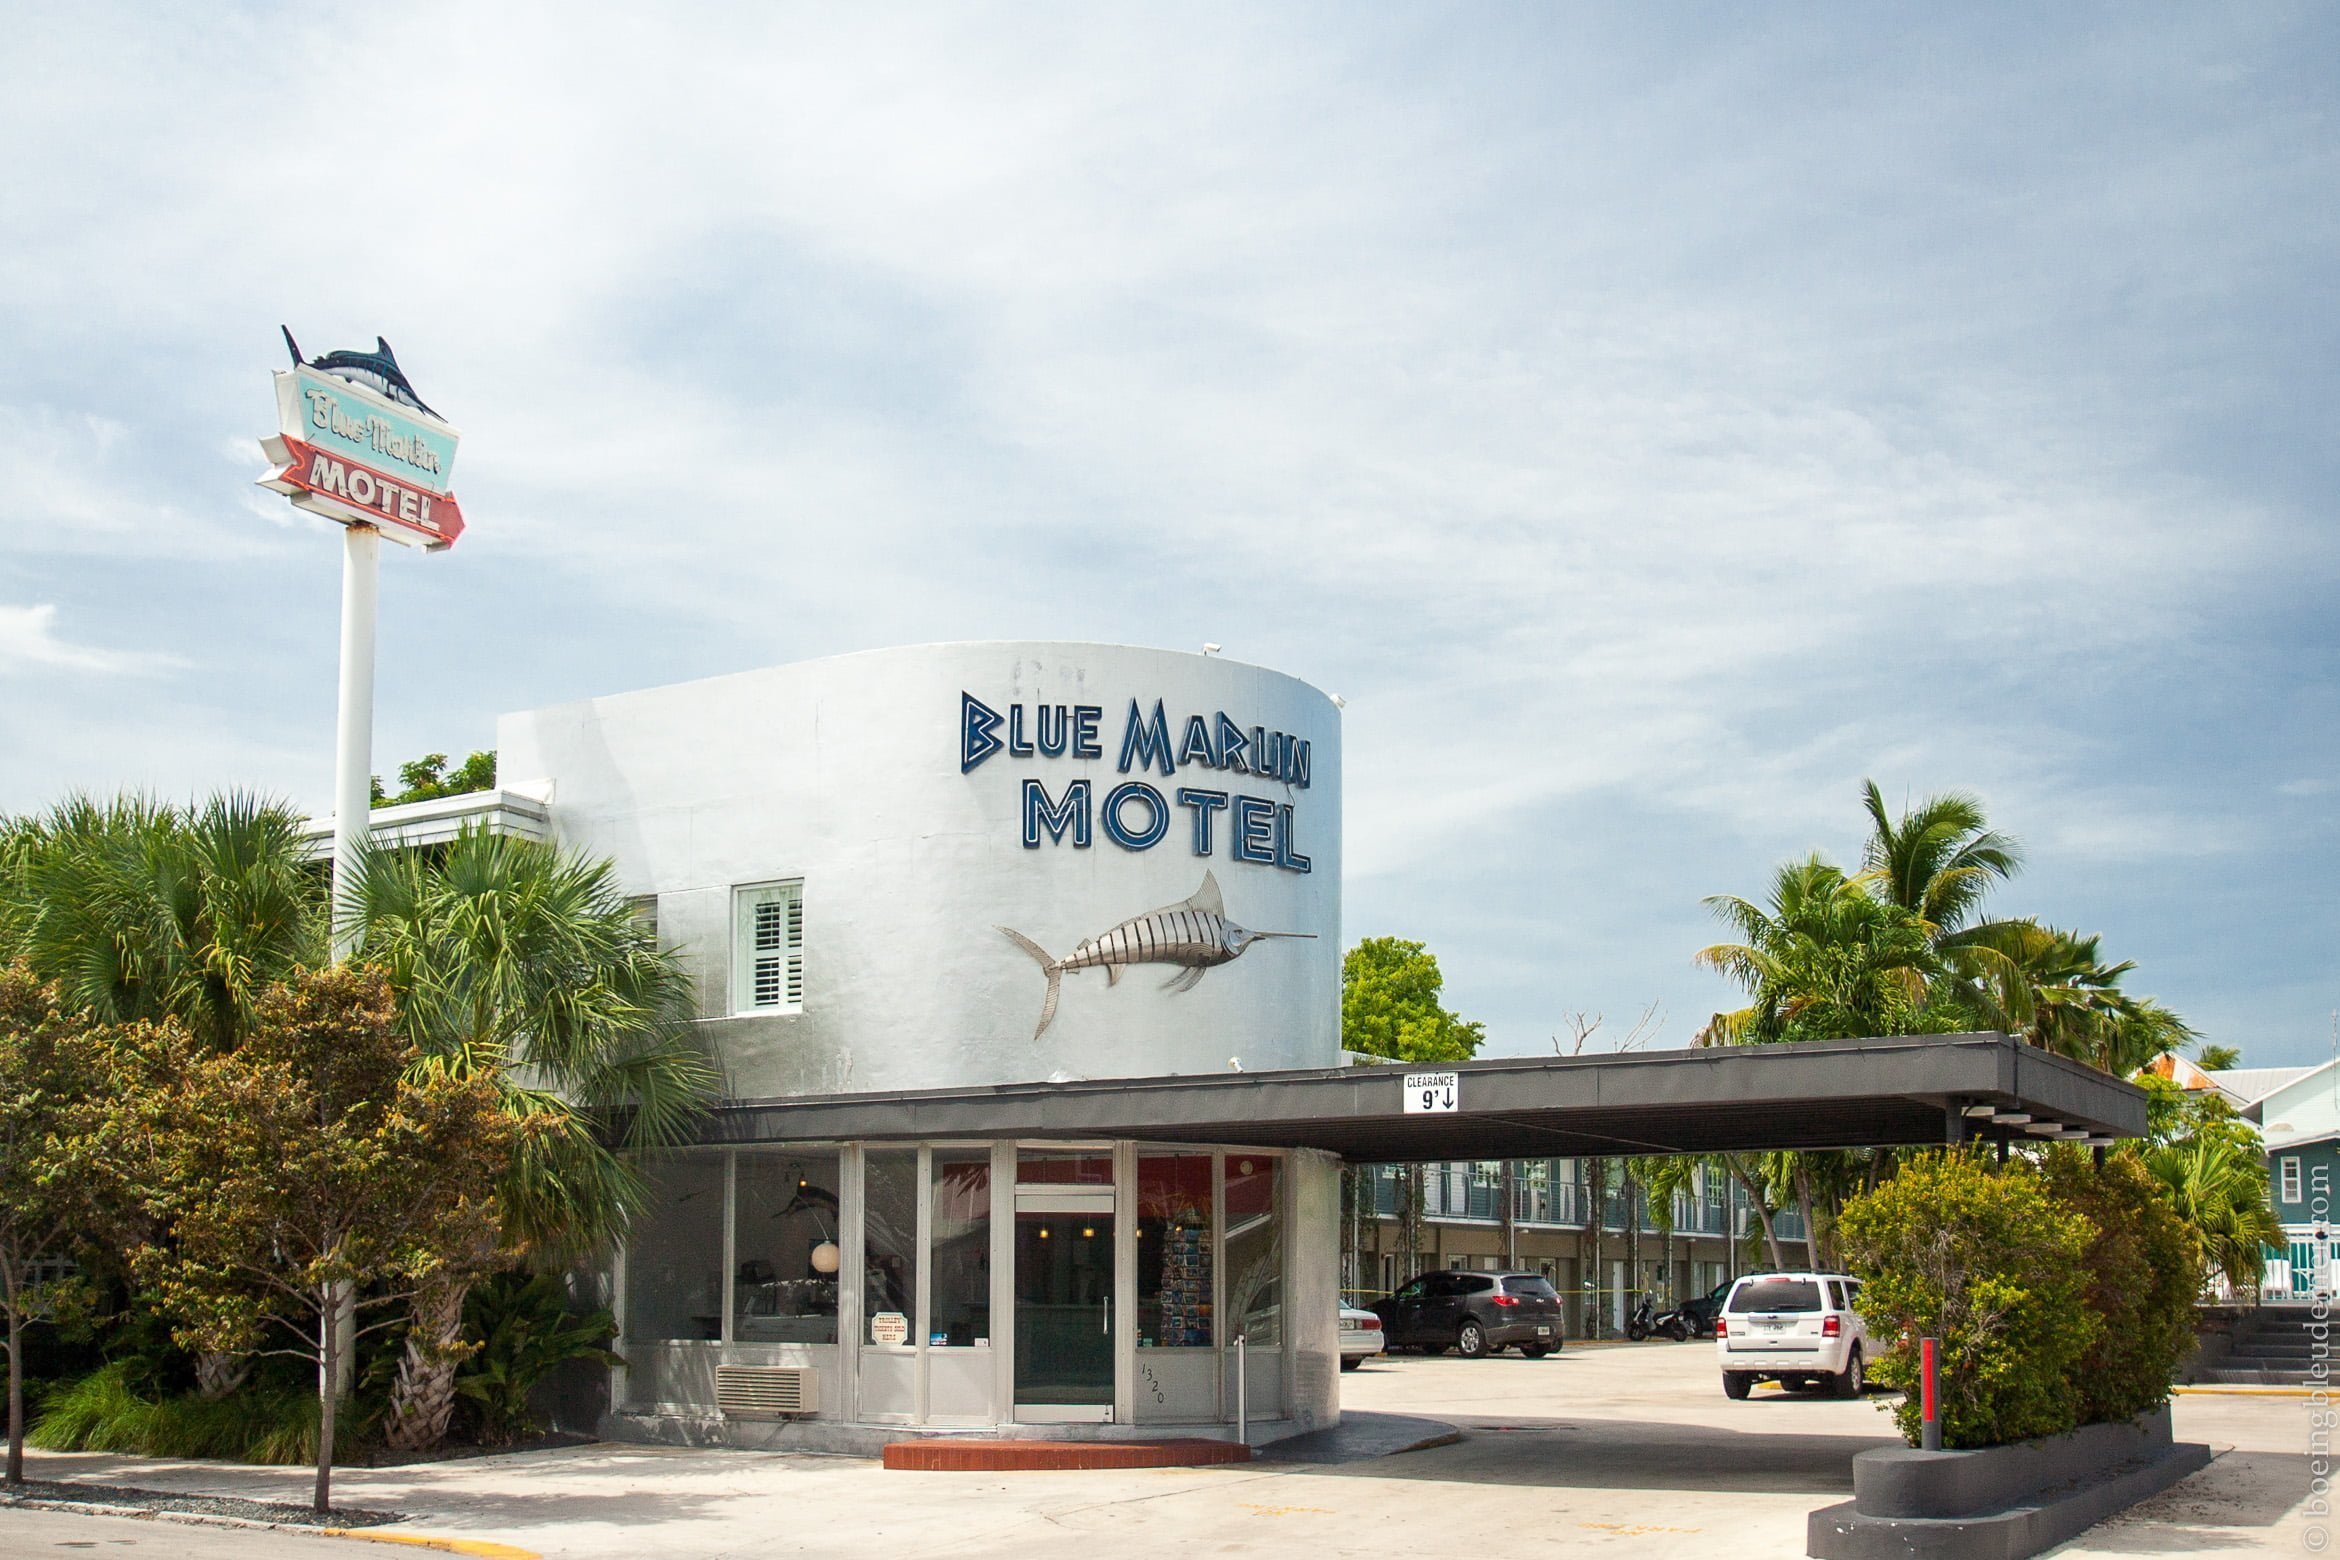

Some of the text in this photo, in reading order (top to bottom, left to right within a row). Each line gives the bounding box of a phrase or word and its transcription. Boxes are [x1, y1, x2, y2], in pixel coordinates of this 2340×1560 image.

[305, 388, 442, 475] Blue Marlin
[309, 454, 440, 531] MOTEL
[961, 690, 1311, 789] BLUE MARLIN
[1022, 778, 1312, 874] MOTEL
[1407, 1075, 1454, 1088] CLEARANCE
[1142, 1363, 1165, 1404] 1320
